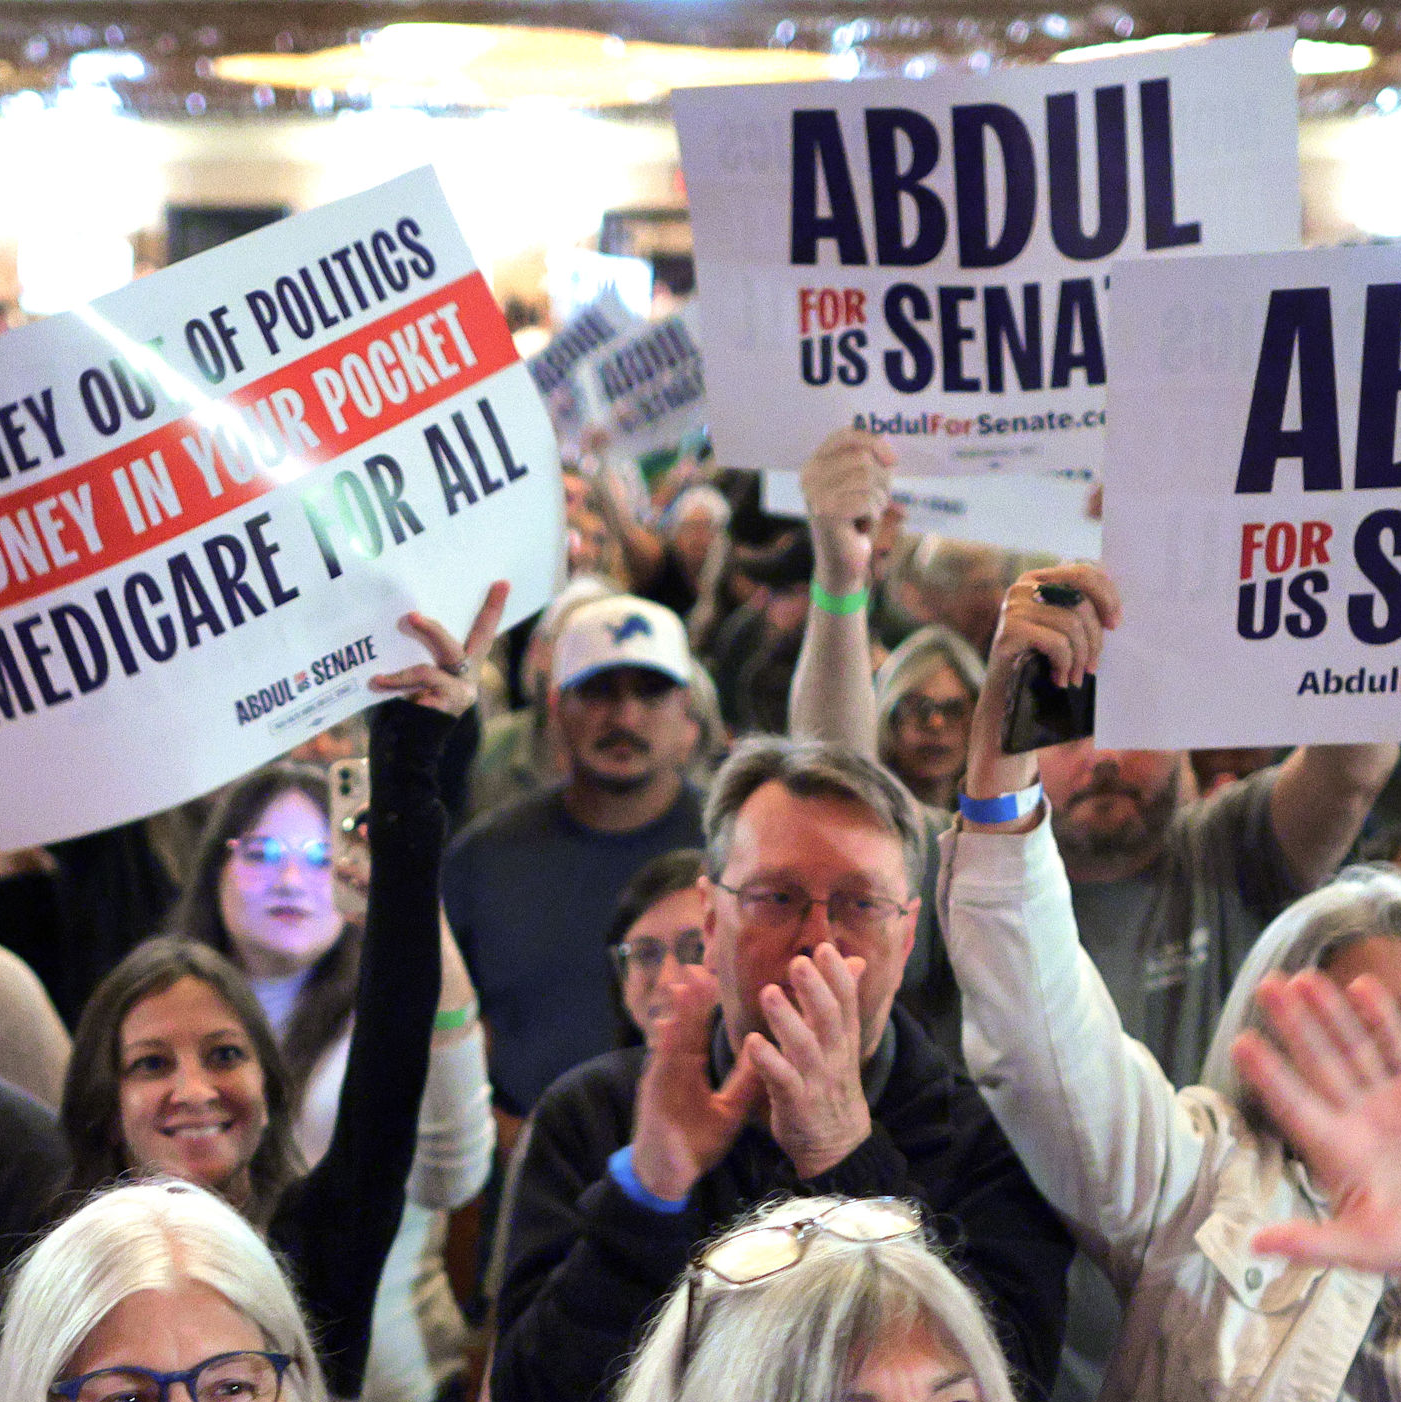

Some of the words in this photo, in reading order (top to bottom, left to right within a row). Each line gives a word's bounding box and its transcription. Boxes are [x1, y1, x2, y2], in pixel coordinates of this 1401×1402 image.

[790, 78, 1201, 269] ABDUL
[79, 335, 178, 437] OU
[185, 306, 244, 385] OF
[245, 216, 436, 355] POLITICS
[799, 288, 867, 334] FOR
[883, 276, 1110, 394] SENA
[801, 329, 869, 386] US
[111, 450, 183, 536] IN
[311, 303, 479, 435] POCKET
[423, 398, 529, 517] ALL
[853, 410, 1107, 437] AbdulForSenate.c
[1239, 520, 1333, 579] FOR
[1236, 571, 1329, 640] US
[235, 677, 296, 726] ABDUL
[311, 635, 378, 686] SENATE
